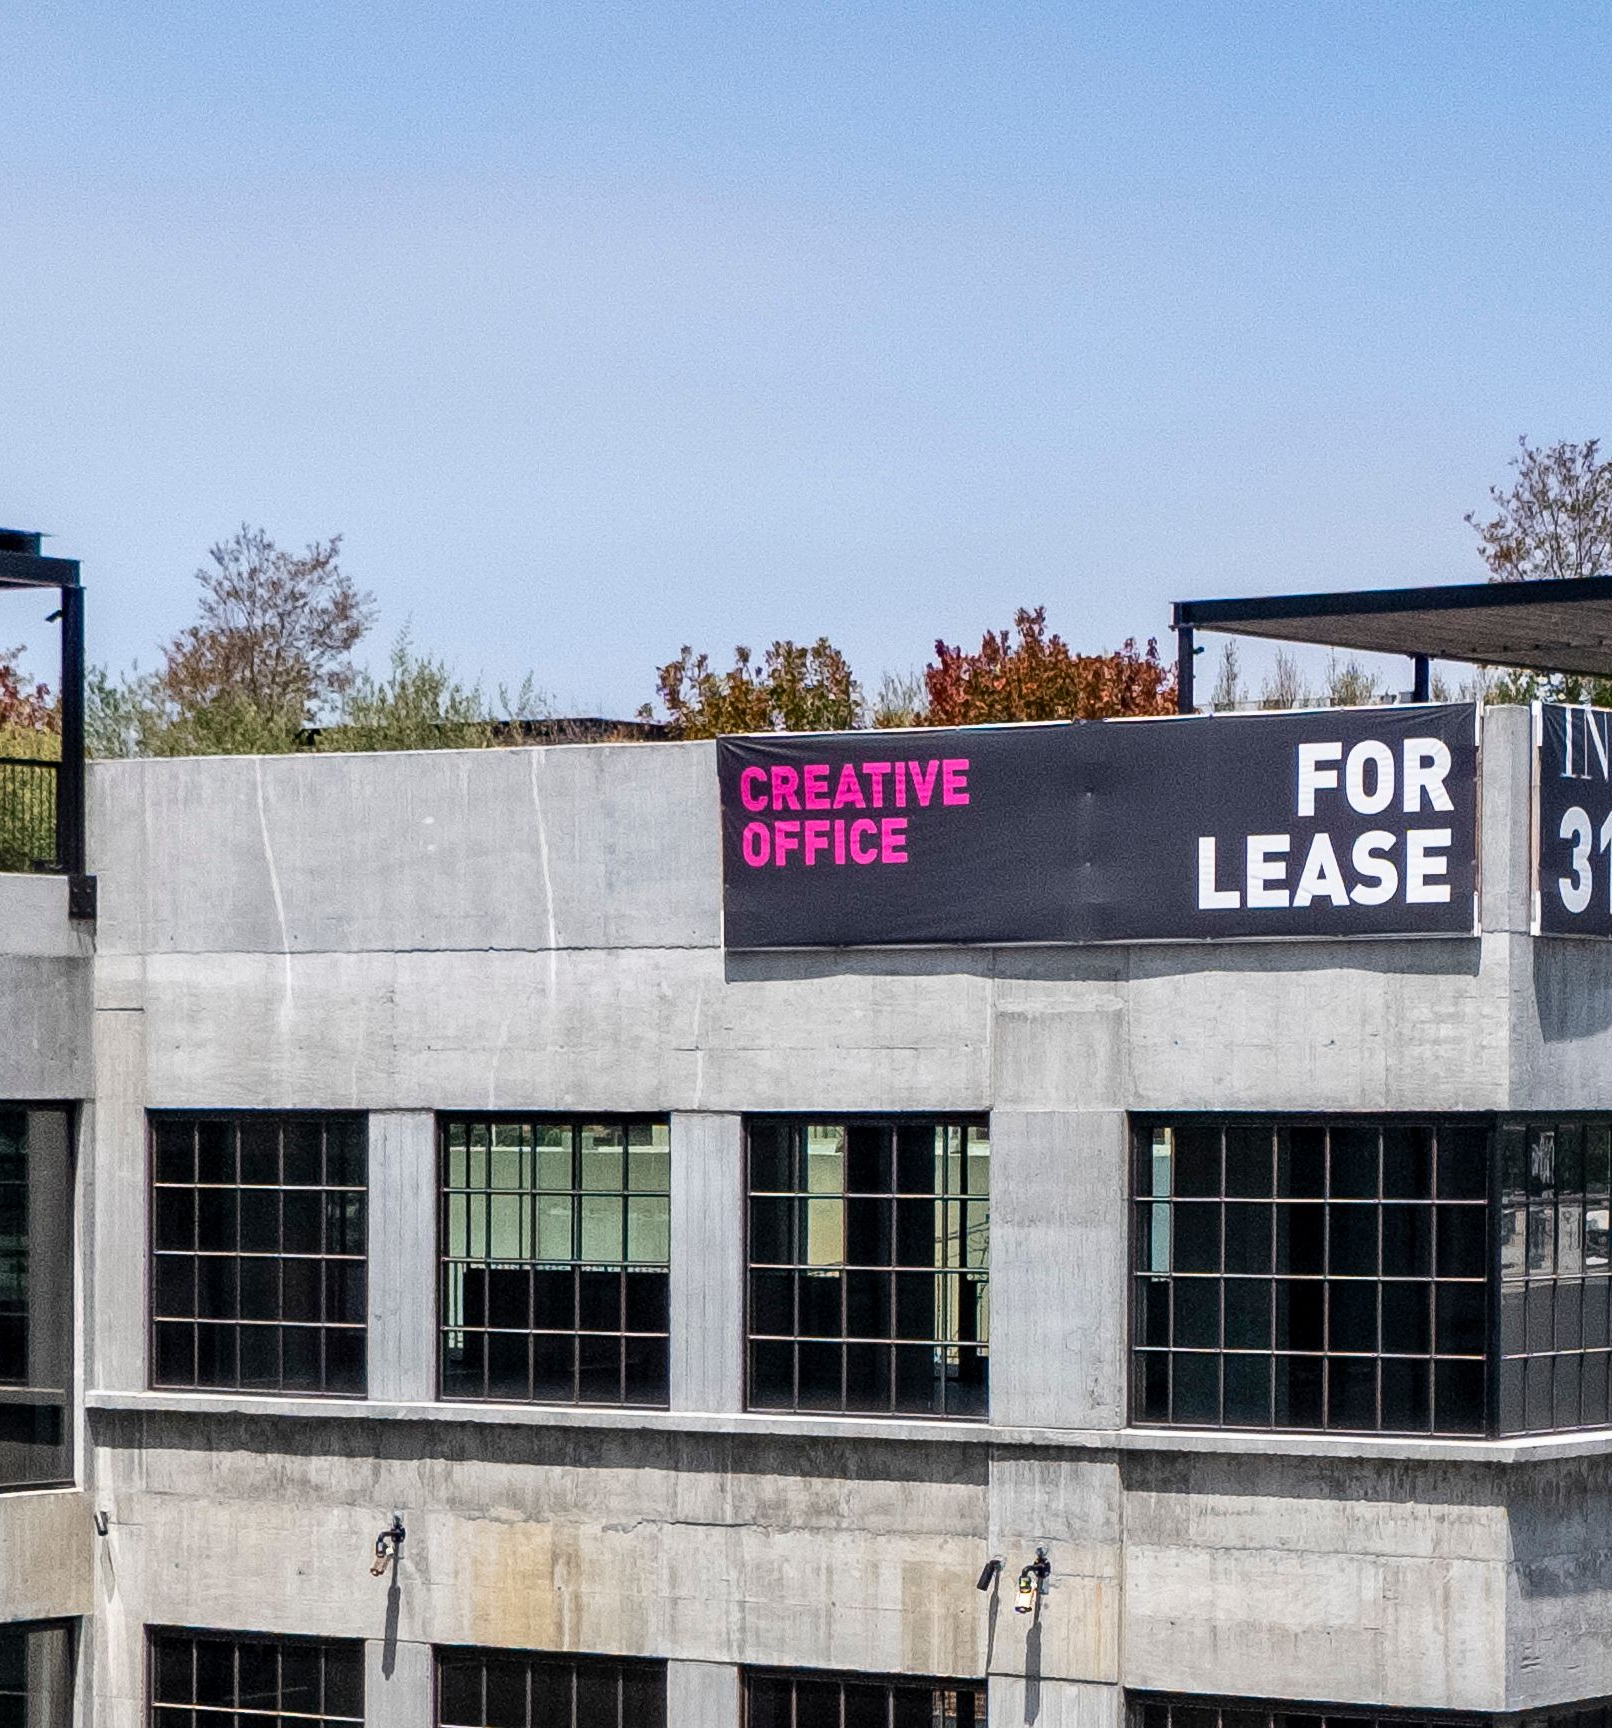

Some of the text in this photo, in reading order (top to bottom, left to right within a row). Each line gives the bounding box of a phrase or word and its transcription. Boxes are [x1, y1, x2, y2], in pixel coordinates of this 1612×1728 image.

[740, 759, 970, 812] CREATIVE
[1298, 738, 1454, 816] FOR
[742, 817, 908, 868] OFFICE
[1199, 828, 1452, 909] LEASE
